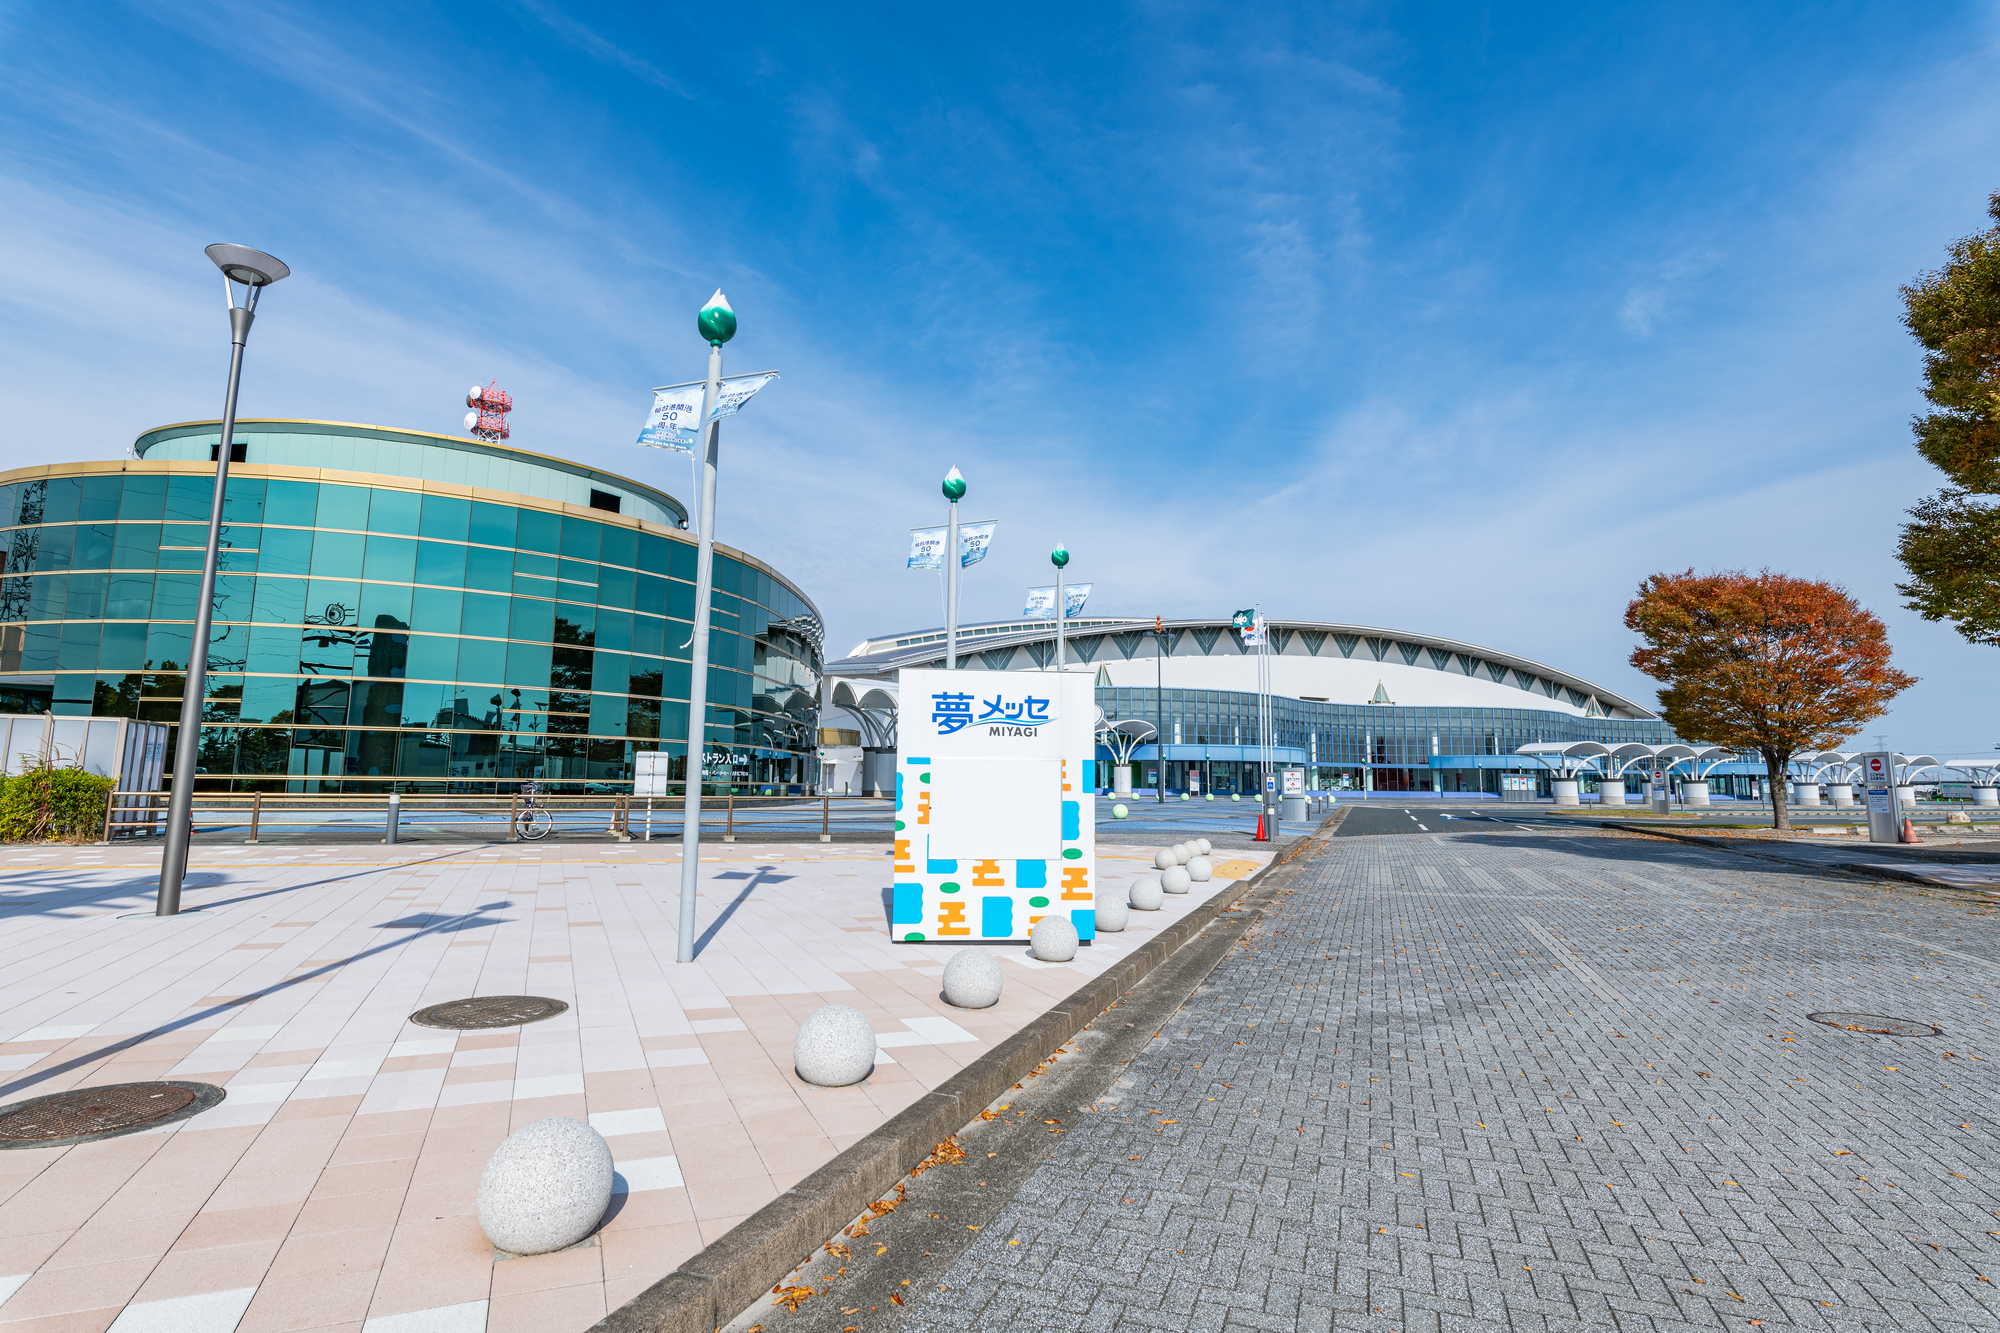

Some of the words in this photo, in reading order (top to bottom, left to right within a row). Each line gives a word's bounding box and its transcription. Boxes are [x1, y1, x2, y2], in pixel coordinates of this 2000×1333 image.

[654, 404, 693, 414] 仙台港開港
[662, 412, 678, 420] 50
[656, 422, 678, 430] 周年
[932, 692, 1050, 735] 夢メッセ
[989, 727, 1038, 737] MIYAGI
